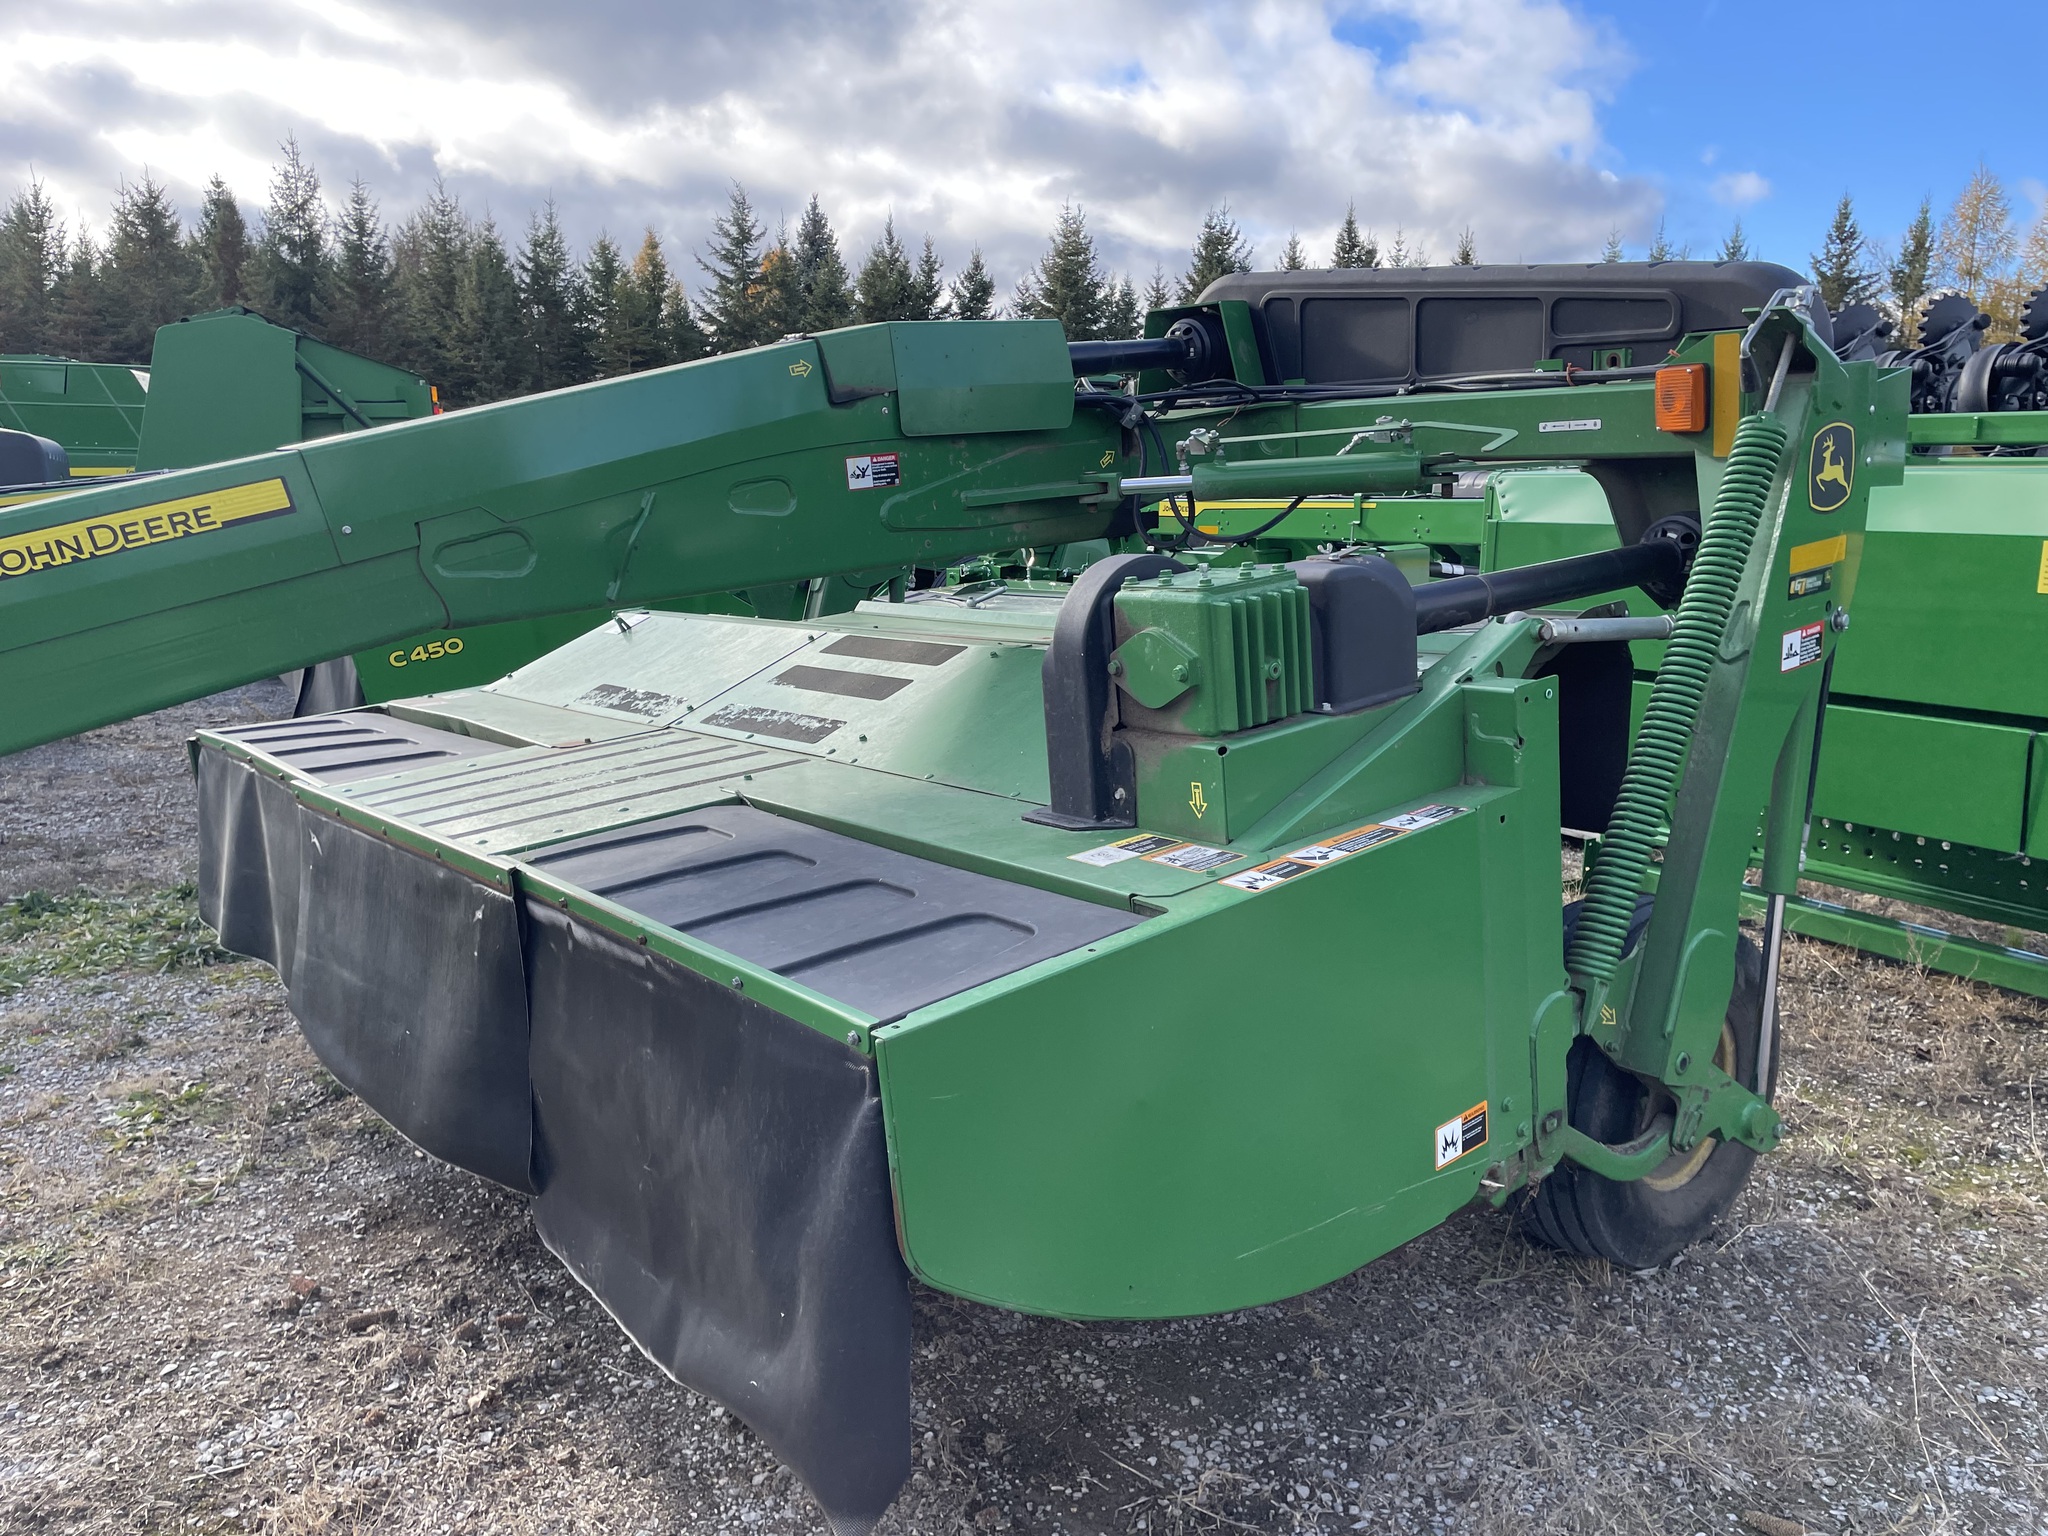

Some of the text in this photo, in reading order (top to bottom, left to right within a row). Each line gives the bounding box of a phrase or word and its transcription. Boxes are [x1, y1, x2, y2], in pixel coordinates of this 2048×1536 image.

[0, 505, 218, 571] OHN DEERE
[388, 637, 464, 668] C 450
